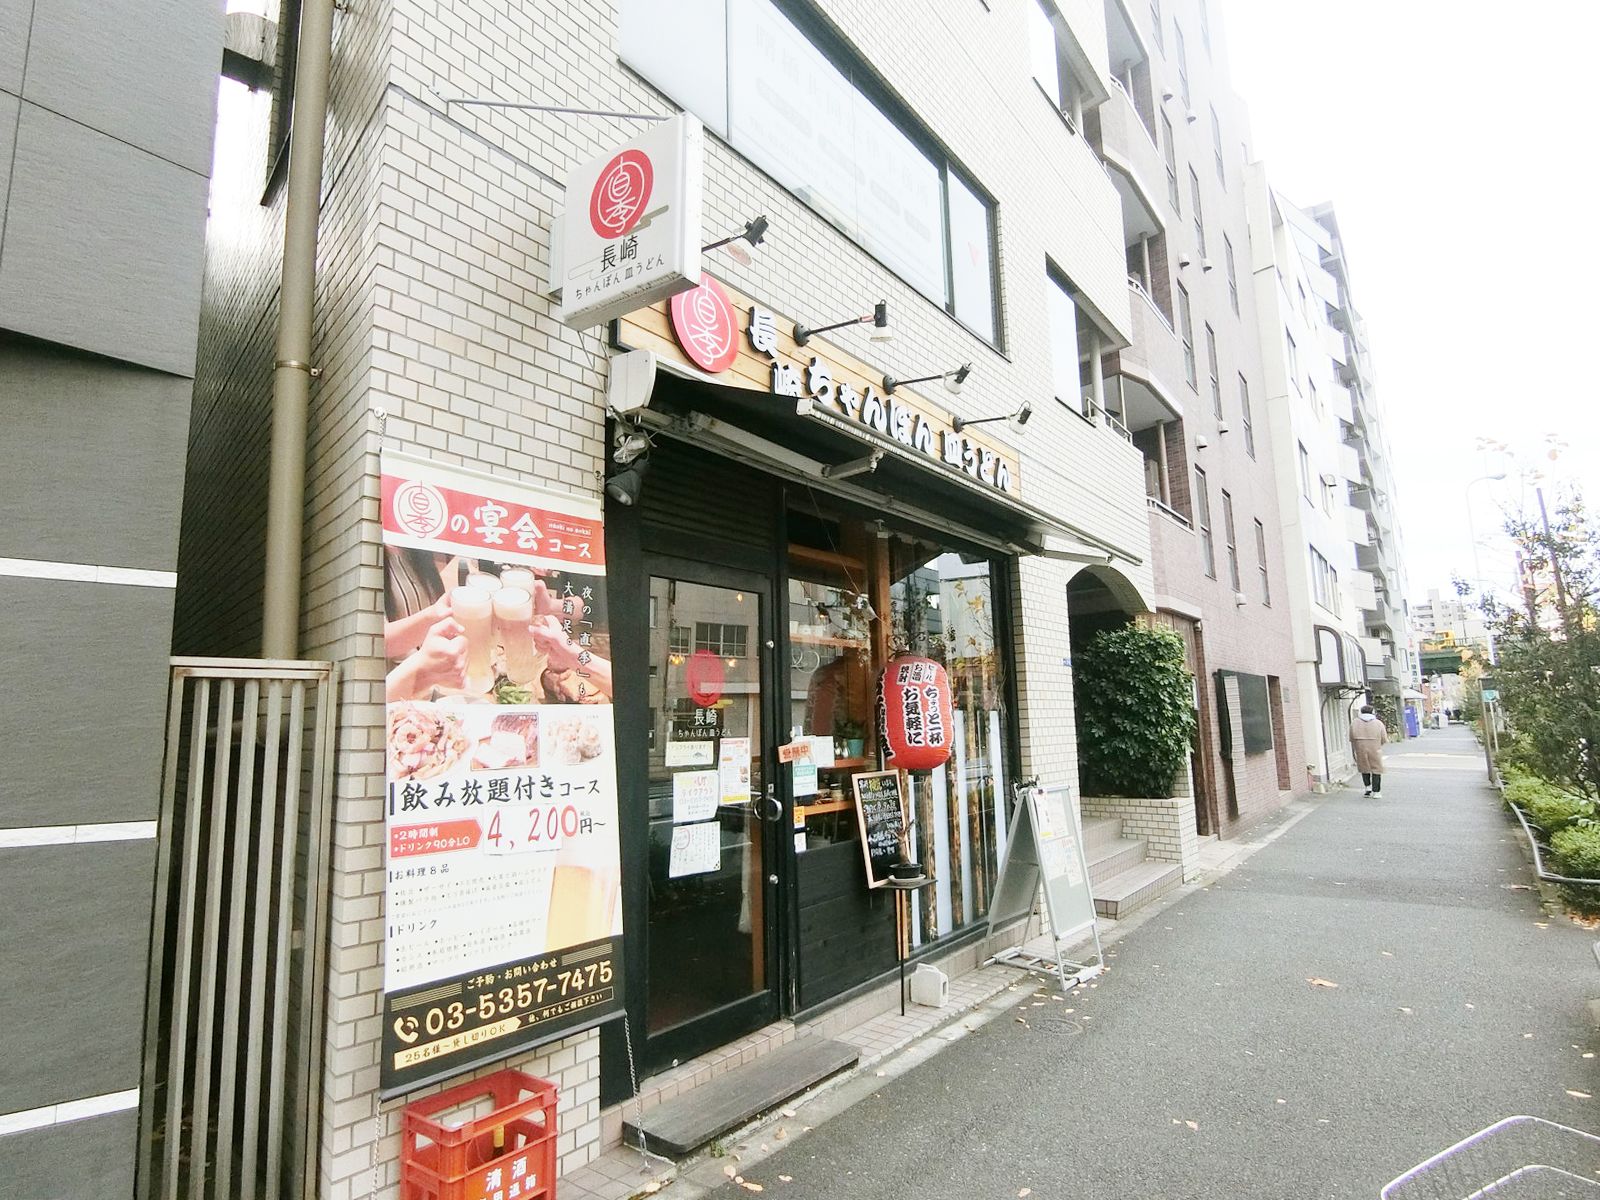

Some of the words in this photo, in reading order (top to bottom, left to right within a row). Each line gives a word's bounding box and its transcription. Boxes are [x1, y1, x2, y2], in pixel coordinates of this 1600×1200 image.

[601, 235, 639, 273] 長崎
[746, 305, 802, 398] 長崎
[561, 580, 576, 647] 大満足。
[694, 708, 718, 727] 長崎
[903, 687, 923, 745] お気軽に
[925, 687, 943, 744] ちょっと一杯
[401, 775, 601, 812] 飲み放題付きコース
[397, 919, 437, 936] ドリンク
[425, 960, 613, 1035] 03-5357-7475
[485, 1156, 527, 1192] 清酒
